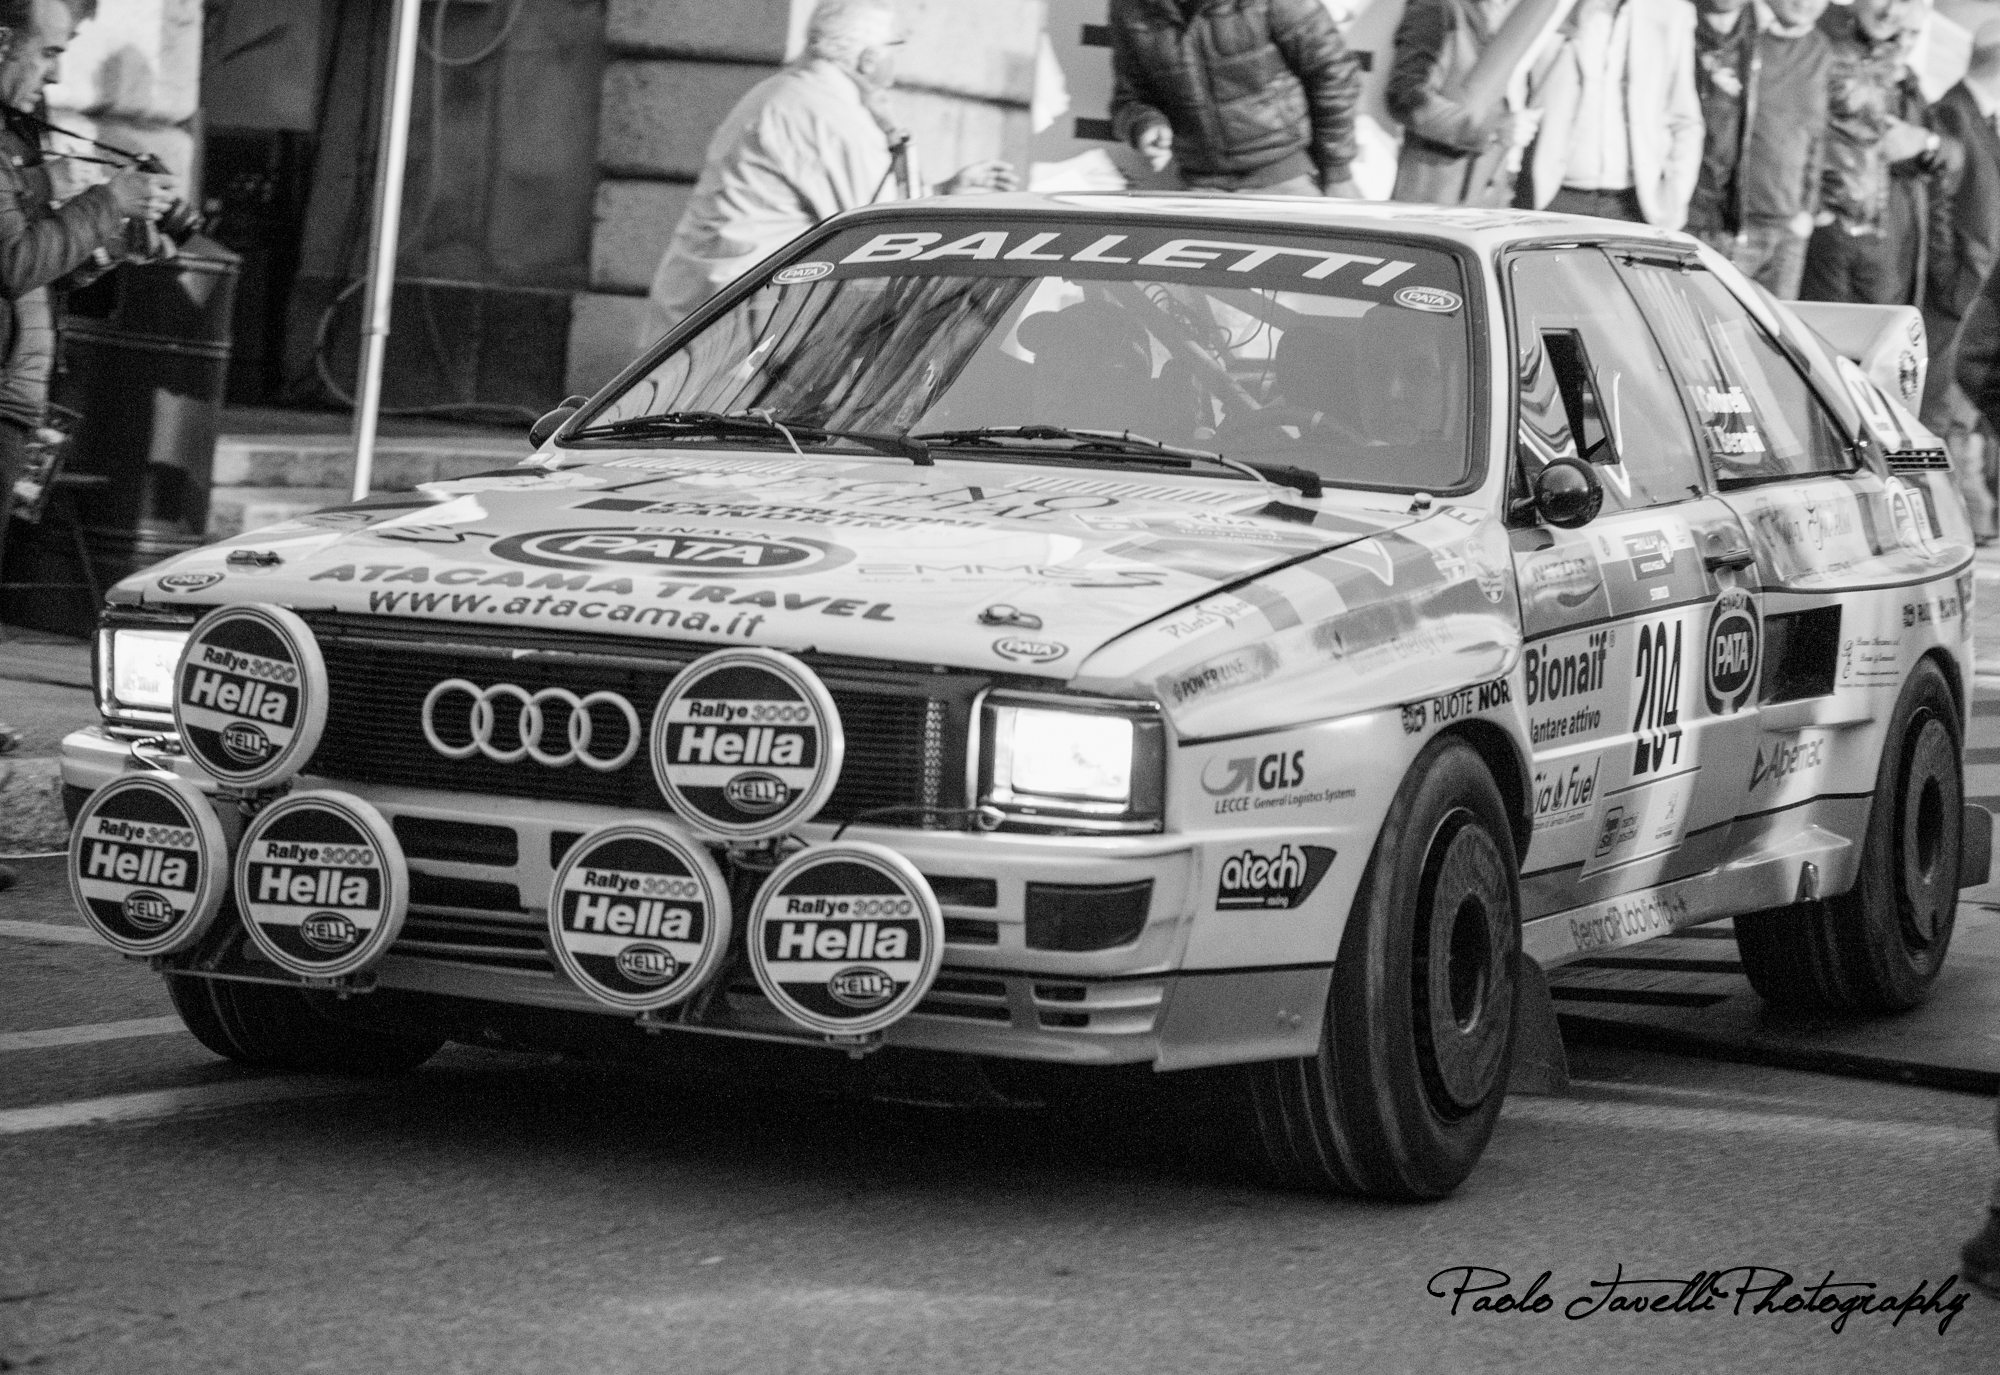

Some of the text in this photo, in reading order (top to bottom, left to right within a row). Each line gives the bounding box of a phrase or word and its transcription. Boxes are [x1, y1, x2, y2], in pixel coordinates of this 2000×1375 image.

[839, 231, 1417, 287] BALLETTI
[1407, 291, 1446, 307] PATA
[559, 535, 765, 566] PATA
[308, 563, 896, 622] ATACAMA TRAVEL
[368, 590, 766, 637] www.atacama.it
[203, 646, 297, 684] Rallye 3000
[1714, 630, 1749, 677] PATA
[189, 668, 288, 723] Hella
[689, 701, 811, 722] Rallye 3000
[1433, 690, 1473, 724] RUOTE
[1632, 618, 1683, 776] 204
[1568, 705, 1601, 736] attivo
[677, 725, 805, 765] Hella
[1258, 749, 1305, 791] GLS
[1563, 756, 1601, 809] Fuel
[730, 780, 788, 804] HELLA
[1214, 787, 1357, 815] LECCE General Logistics Systems
[98, 819, 196, 848] Rallye 3000
[88, 841, 189, 888] Hella
[266, 841, 375, 866] Rallye 3000
[1220, 845, 1302, 890] atech
[258, 866, 370, 907] Hella
[584, 870, 699, 898] Rallye 3000
[572, 893, 693, 940] Hella
[786, 898, 914, 917] Rallye 3000
[777, 921, 909, 960] Hella
[622, 951, 676, 977] HELLA
[834, 974, 894, 998] HELLA
